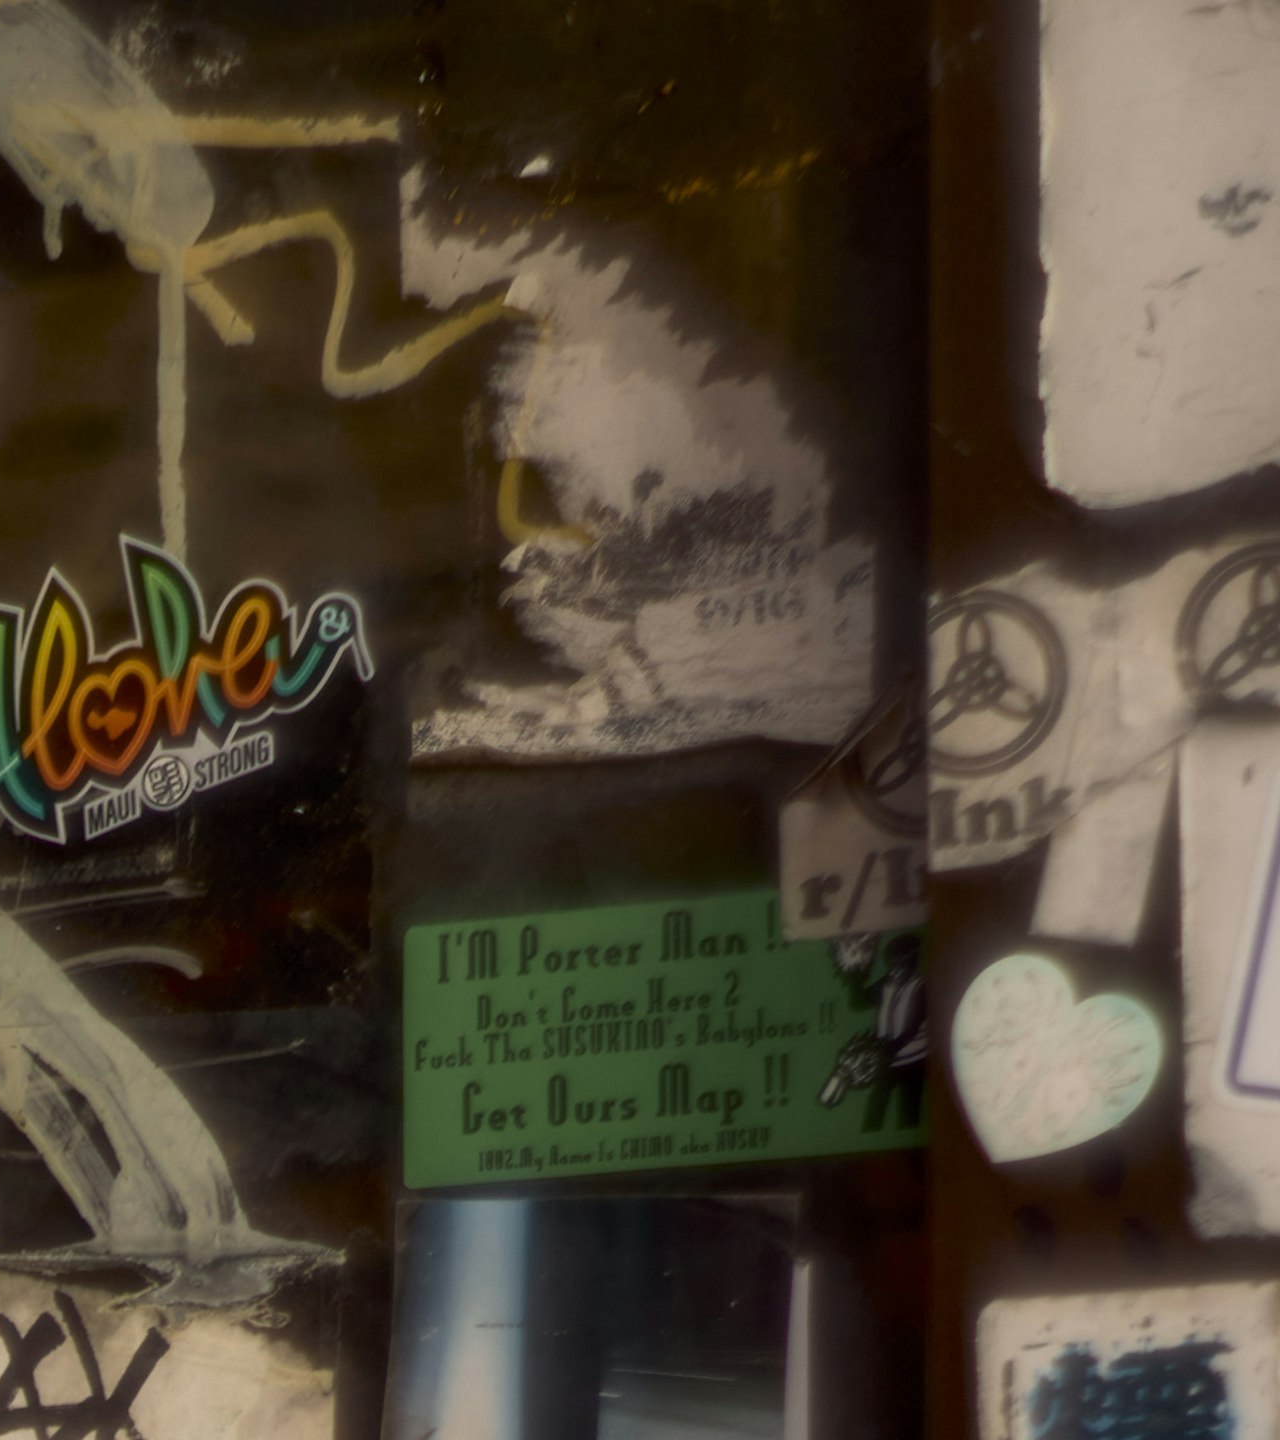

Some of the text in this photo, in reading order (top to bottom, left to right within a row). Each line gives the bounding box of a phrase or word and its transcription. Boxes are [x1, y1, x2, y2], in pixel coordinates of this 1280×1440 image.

[88, 738, 271, 835] MAUI STRONG
[436, 910, 749, 985] I'M Porter Man
[415, 1039, 474, 1072] Fuck
[483, 1034, 532, 1066] Tha
[695, 1011, 808, 1048] Babylons
[477, 991, 549, 1032] Don't
[561, 985, 635, 1021] Come
[647, 976, 712, 1014] Here
[461, 1054, 791, 1136] Get Ours Map !!
